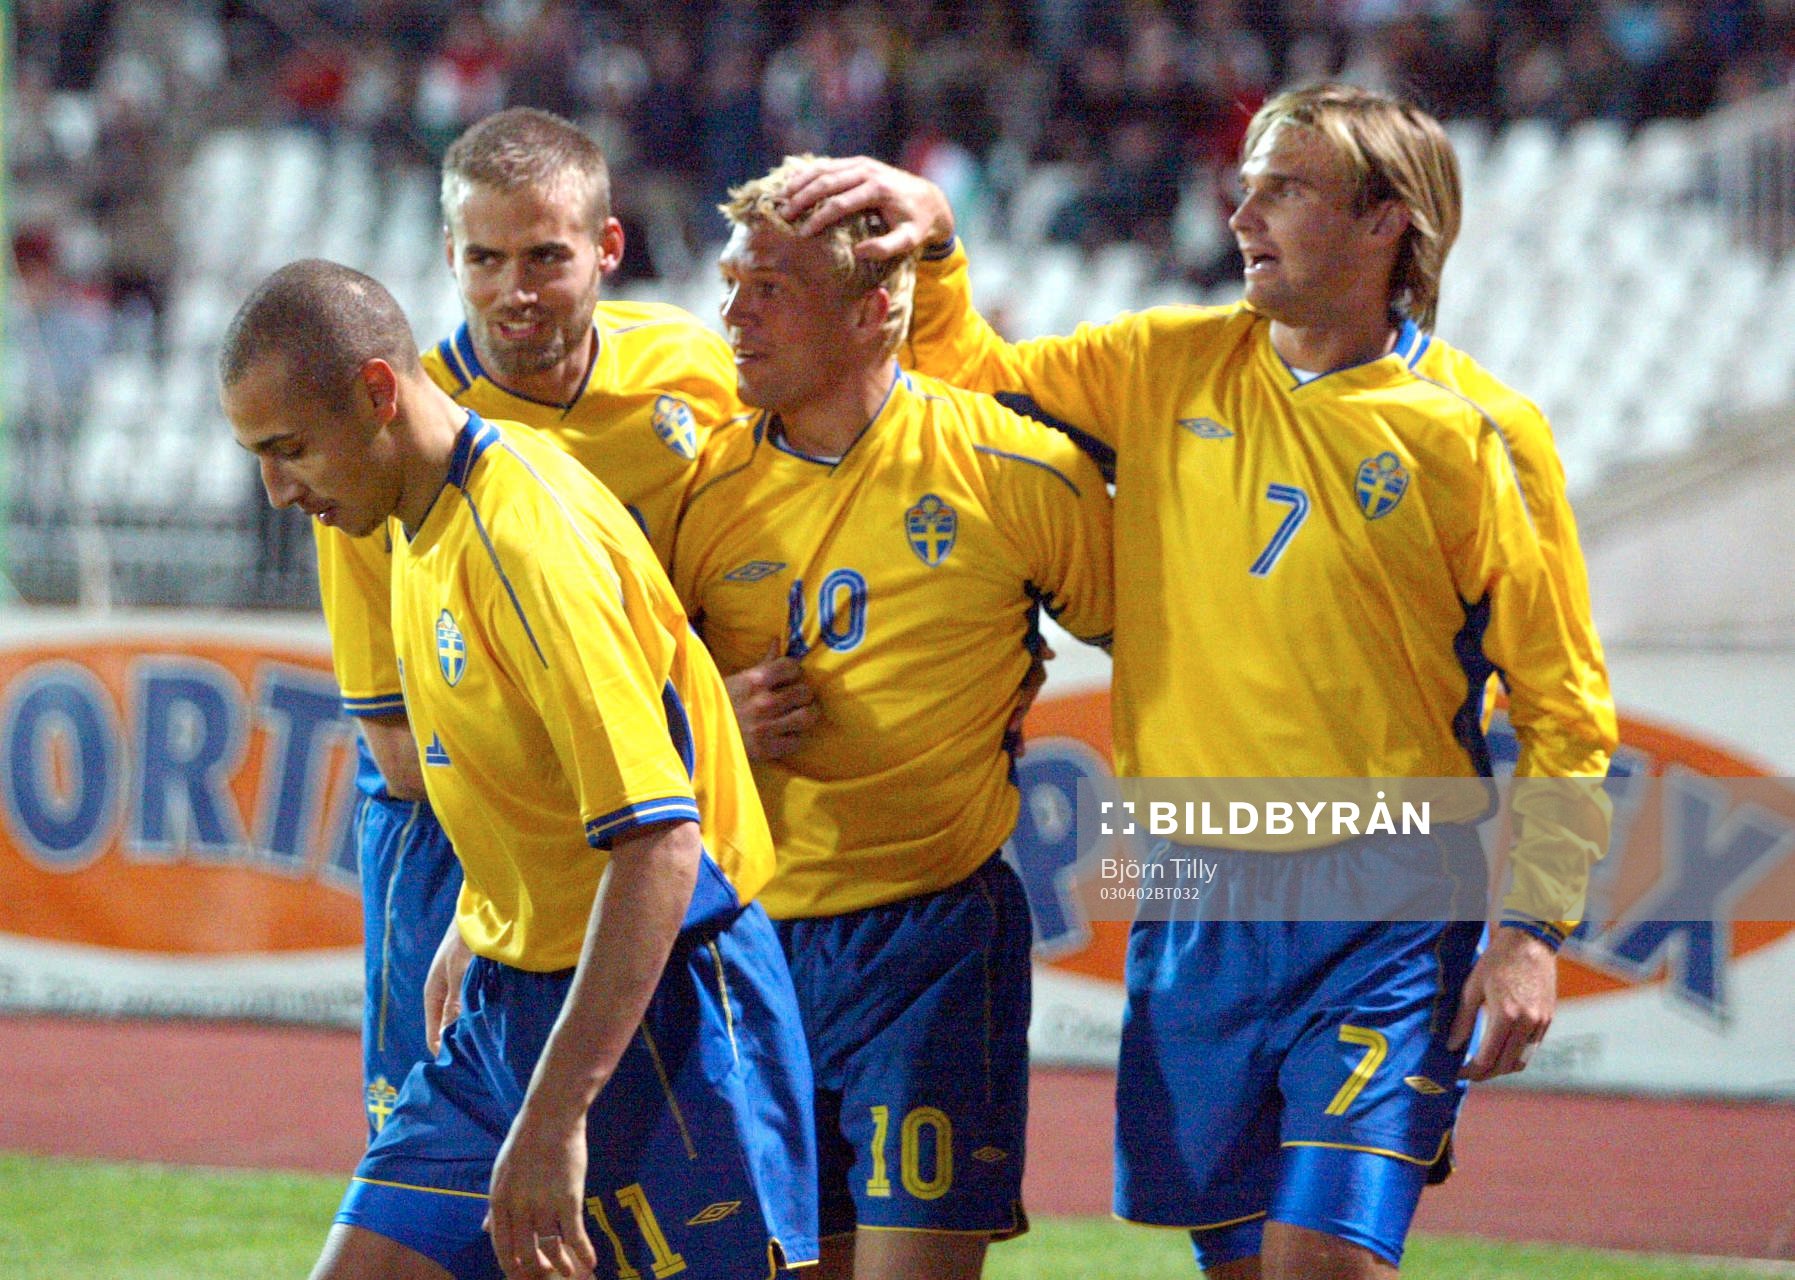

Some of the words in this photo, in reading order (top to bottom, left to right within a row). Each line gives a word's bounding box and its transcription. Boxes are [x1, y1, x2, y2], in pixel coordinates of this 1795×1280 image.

[1249, 482, 1311, 577] 7
[786, 566, 868, 657] 10
[4, 658, 362, 888] ORT
[1324, 1024, 1388, 1116] 7
[867, 1105, 953, 1200] 10
[586, 1183, 687, 1280] 11
